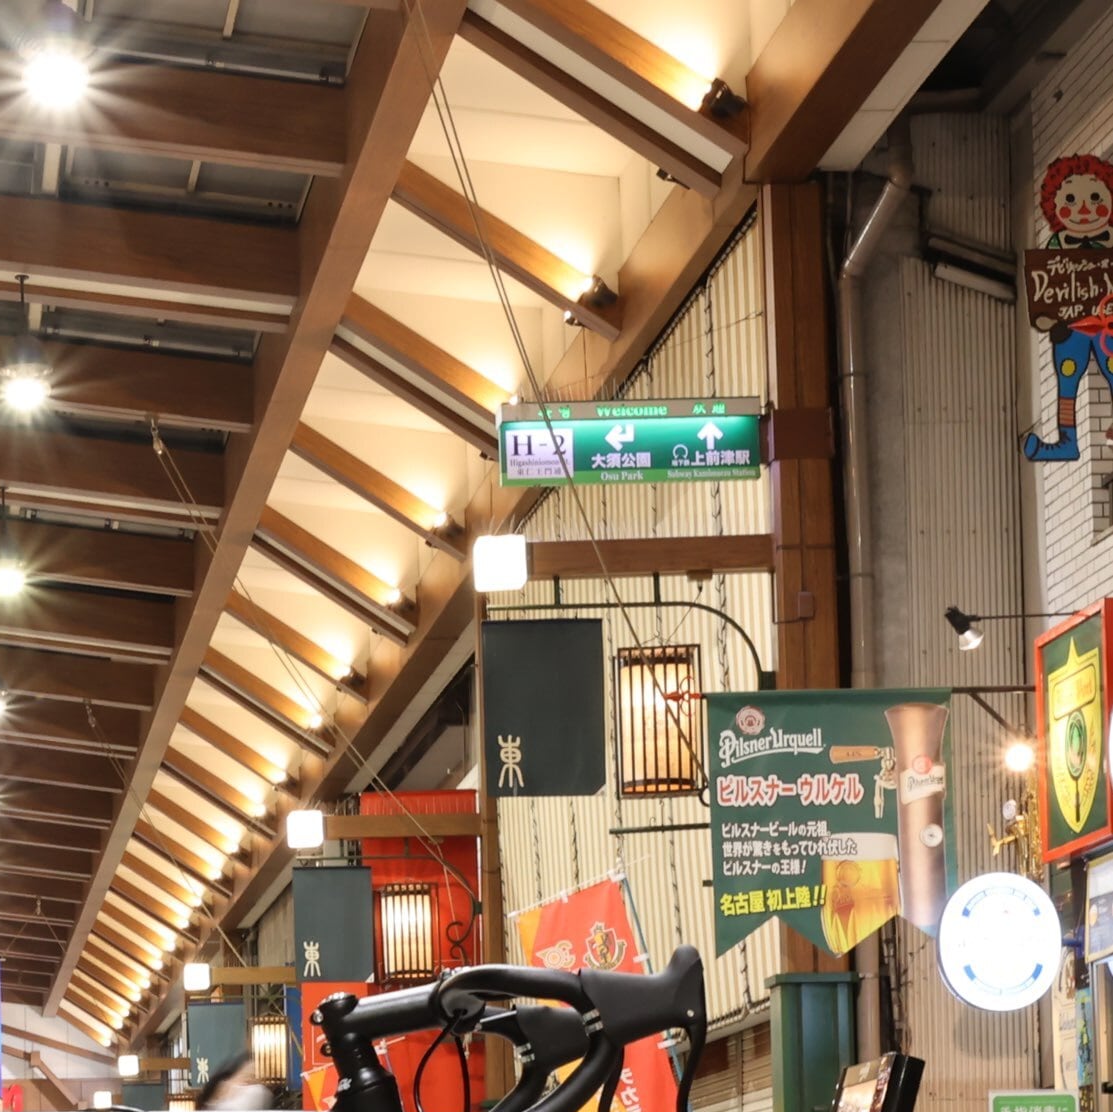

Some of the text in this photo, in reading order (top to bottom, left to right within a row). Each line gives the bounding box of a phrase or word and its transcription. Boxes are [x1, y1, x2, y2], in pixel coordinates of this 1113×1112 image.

[597, 404, 668, 417] Welcome
[591, 452, 651, 469] 大須公園
[690, 449, 751, 467] 上前津駅
[600, 470, 644, 482] Osu Park
[719, 728, 822, 768] Pilsner Urquell
